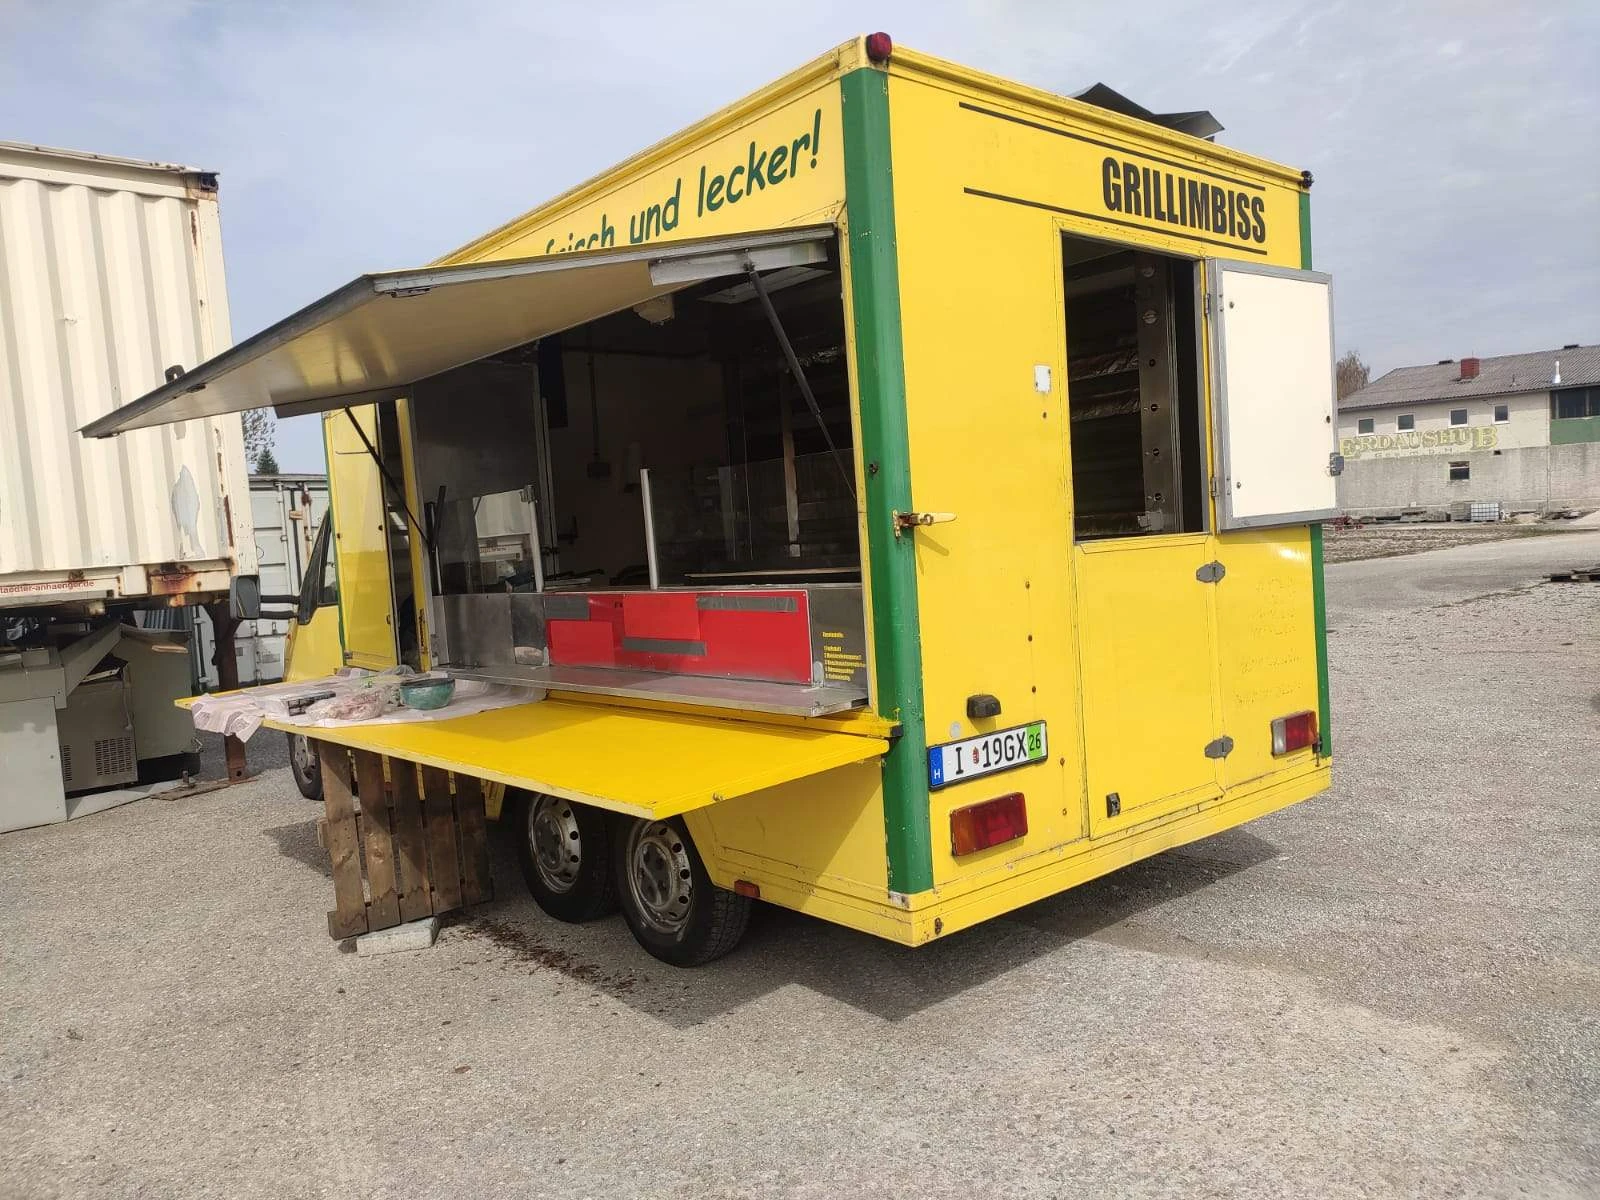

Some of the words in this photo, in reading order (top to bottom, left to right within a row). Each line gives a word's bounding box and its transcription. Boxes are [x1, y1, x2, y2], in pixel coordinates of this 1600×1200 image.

[629, 177, 681, 244] und
[697, 108, 822, 218] lecker!
[1102, 156, 1267, 244] GRILLIMBISS
[1028, 733, 1041, 752] 26
